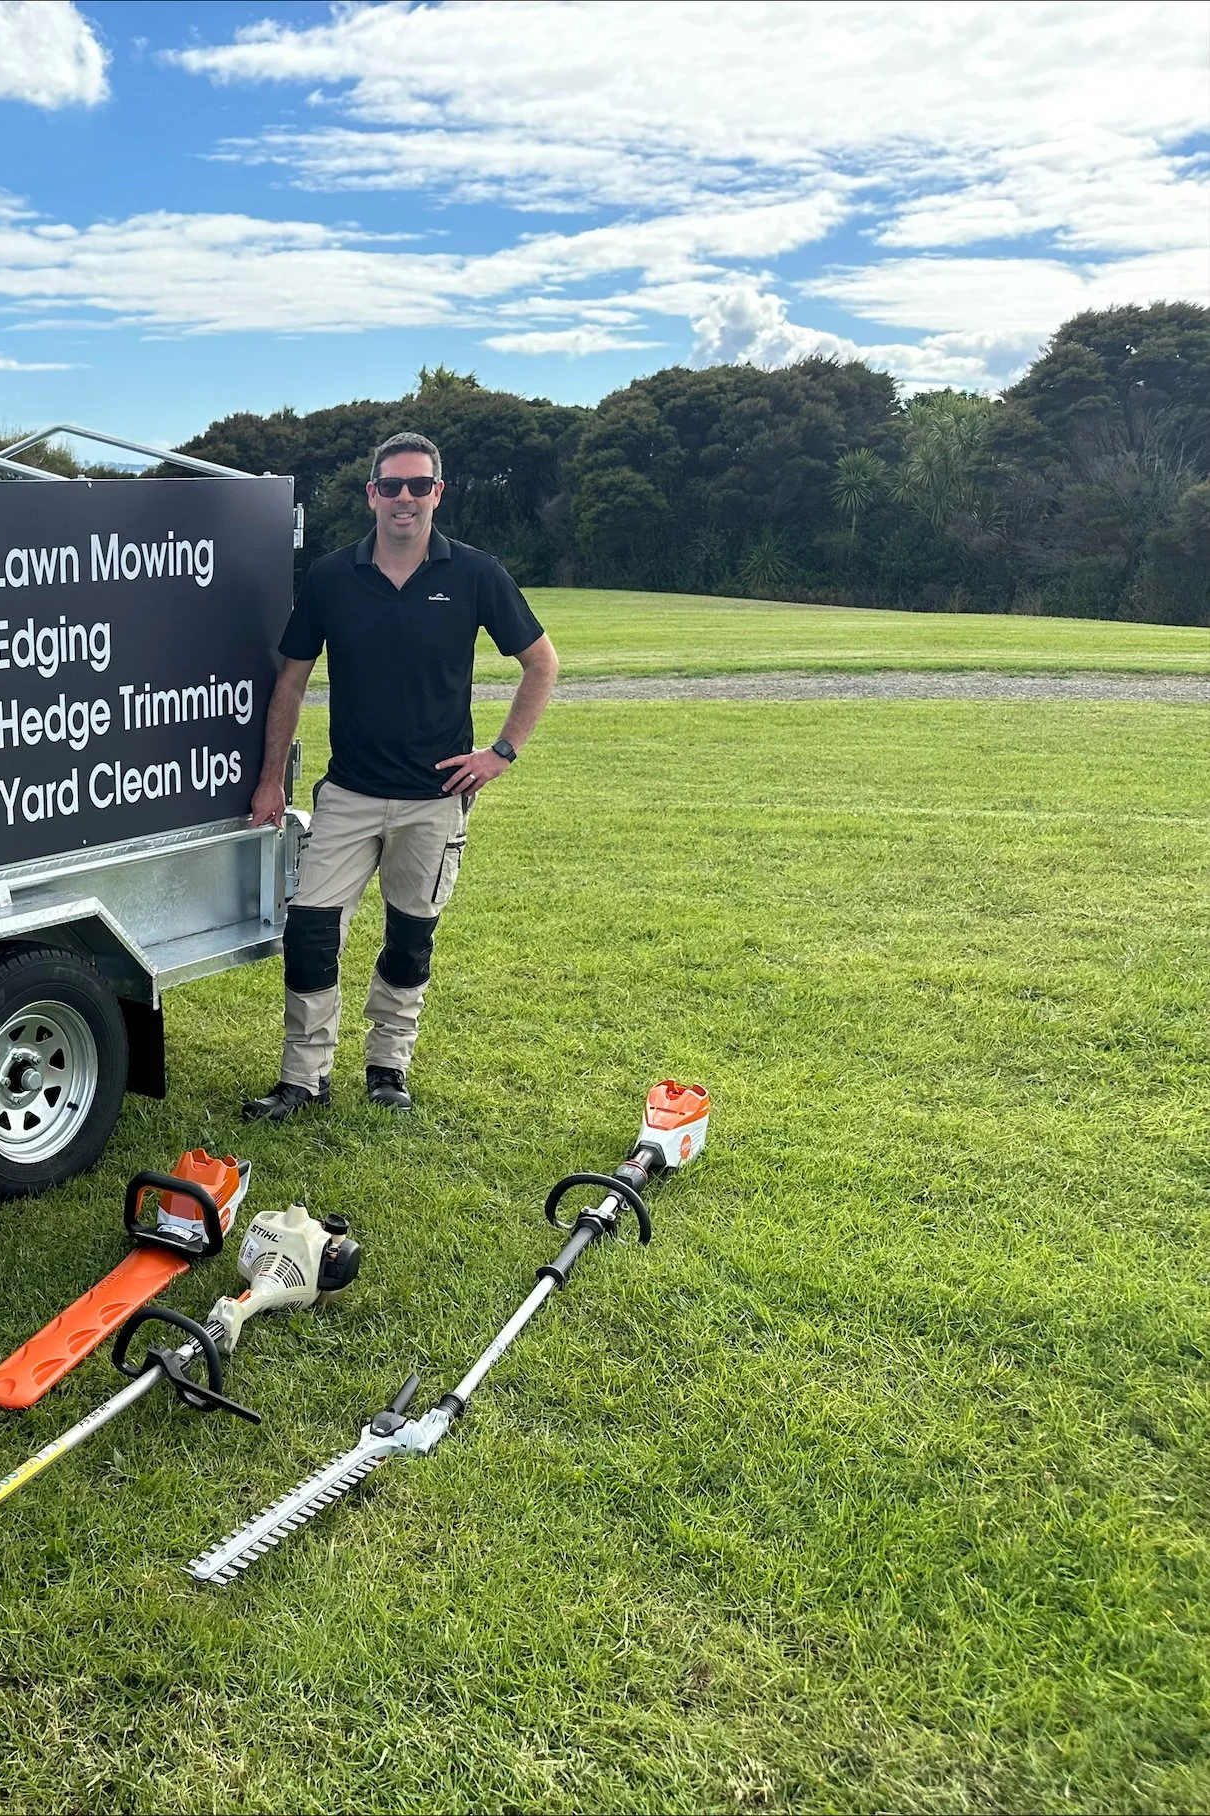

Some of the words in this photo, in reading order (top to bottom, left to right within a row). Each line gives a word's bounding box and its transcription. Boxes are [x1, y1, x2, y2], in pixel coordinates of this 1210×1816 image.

[90, 530, 214, 588] Mowing
[118, 674, 253, 731] Trimming
[88, 760, 182, 809] Clean
[190, 745, 242, 797] Ups
[250, 1224, 279, 1243] STIHL
